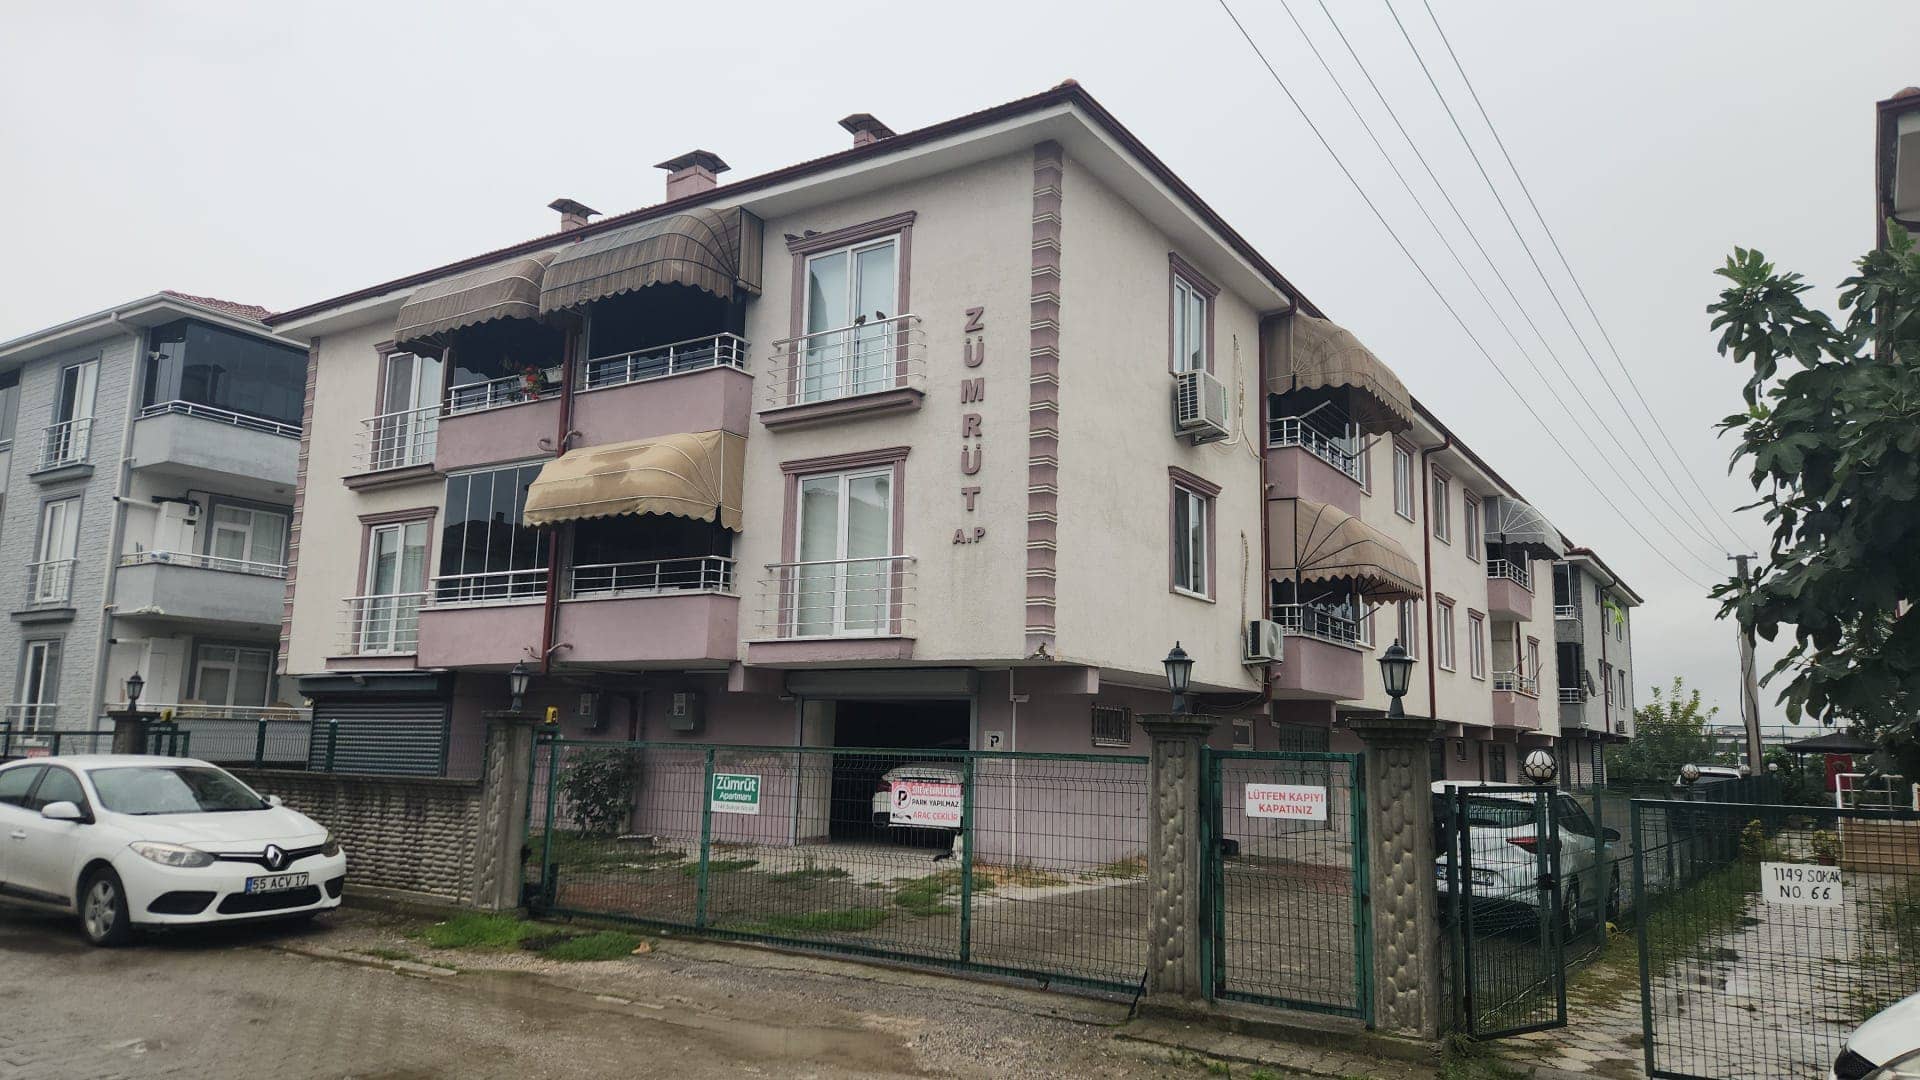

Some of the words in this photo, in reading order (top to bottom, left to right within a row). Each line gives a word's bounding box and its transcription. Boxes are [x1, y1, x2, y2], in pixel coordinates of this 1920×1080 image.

[960, 306, 985, 511] ZÜMRÜT
[716, 776, 756, 792] Zümrüt
[1248, 789, 1286, 800] LÜTFEN
[911, 798, 928, 806] PARK
[929, 800, 960, 808] YAPILMAZ
[912, 810, 930, 820] ARAÇ
[1259, 804, 1313, 815] KAPATINIZ
[1807, 869, 1840, 883] SOKAK
[253, 878, 266, 890] 55
[271, 876, 291, 888] ACV
